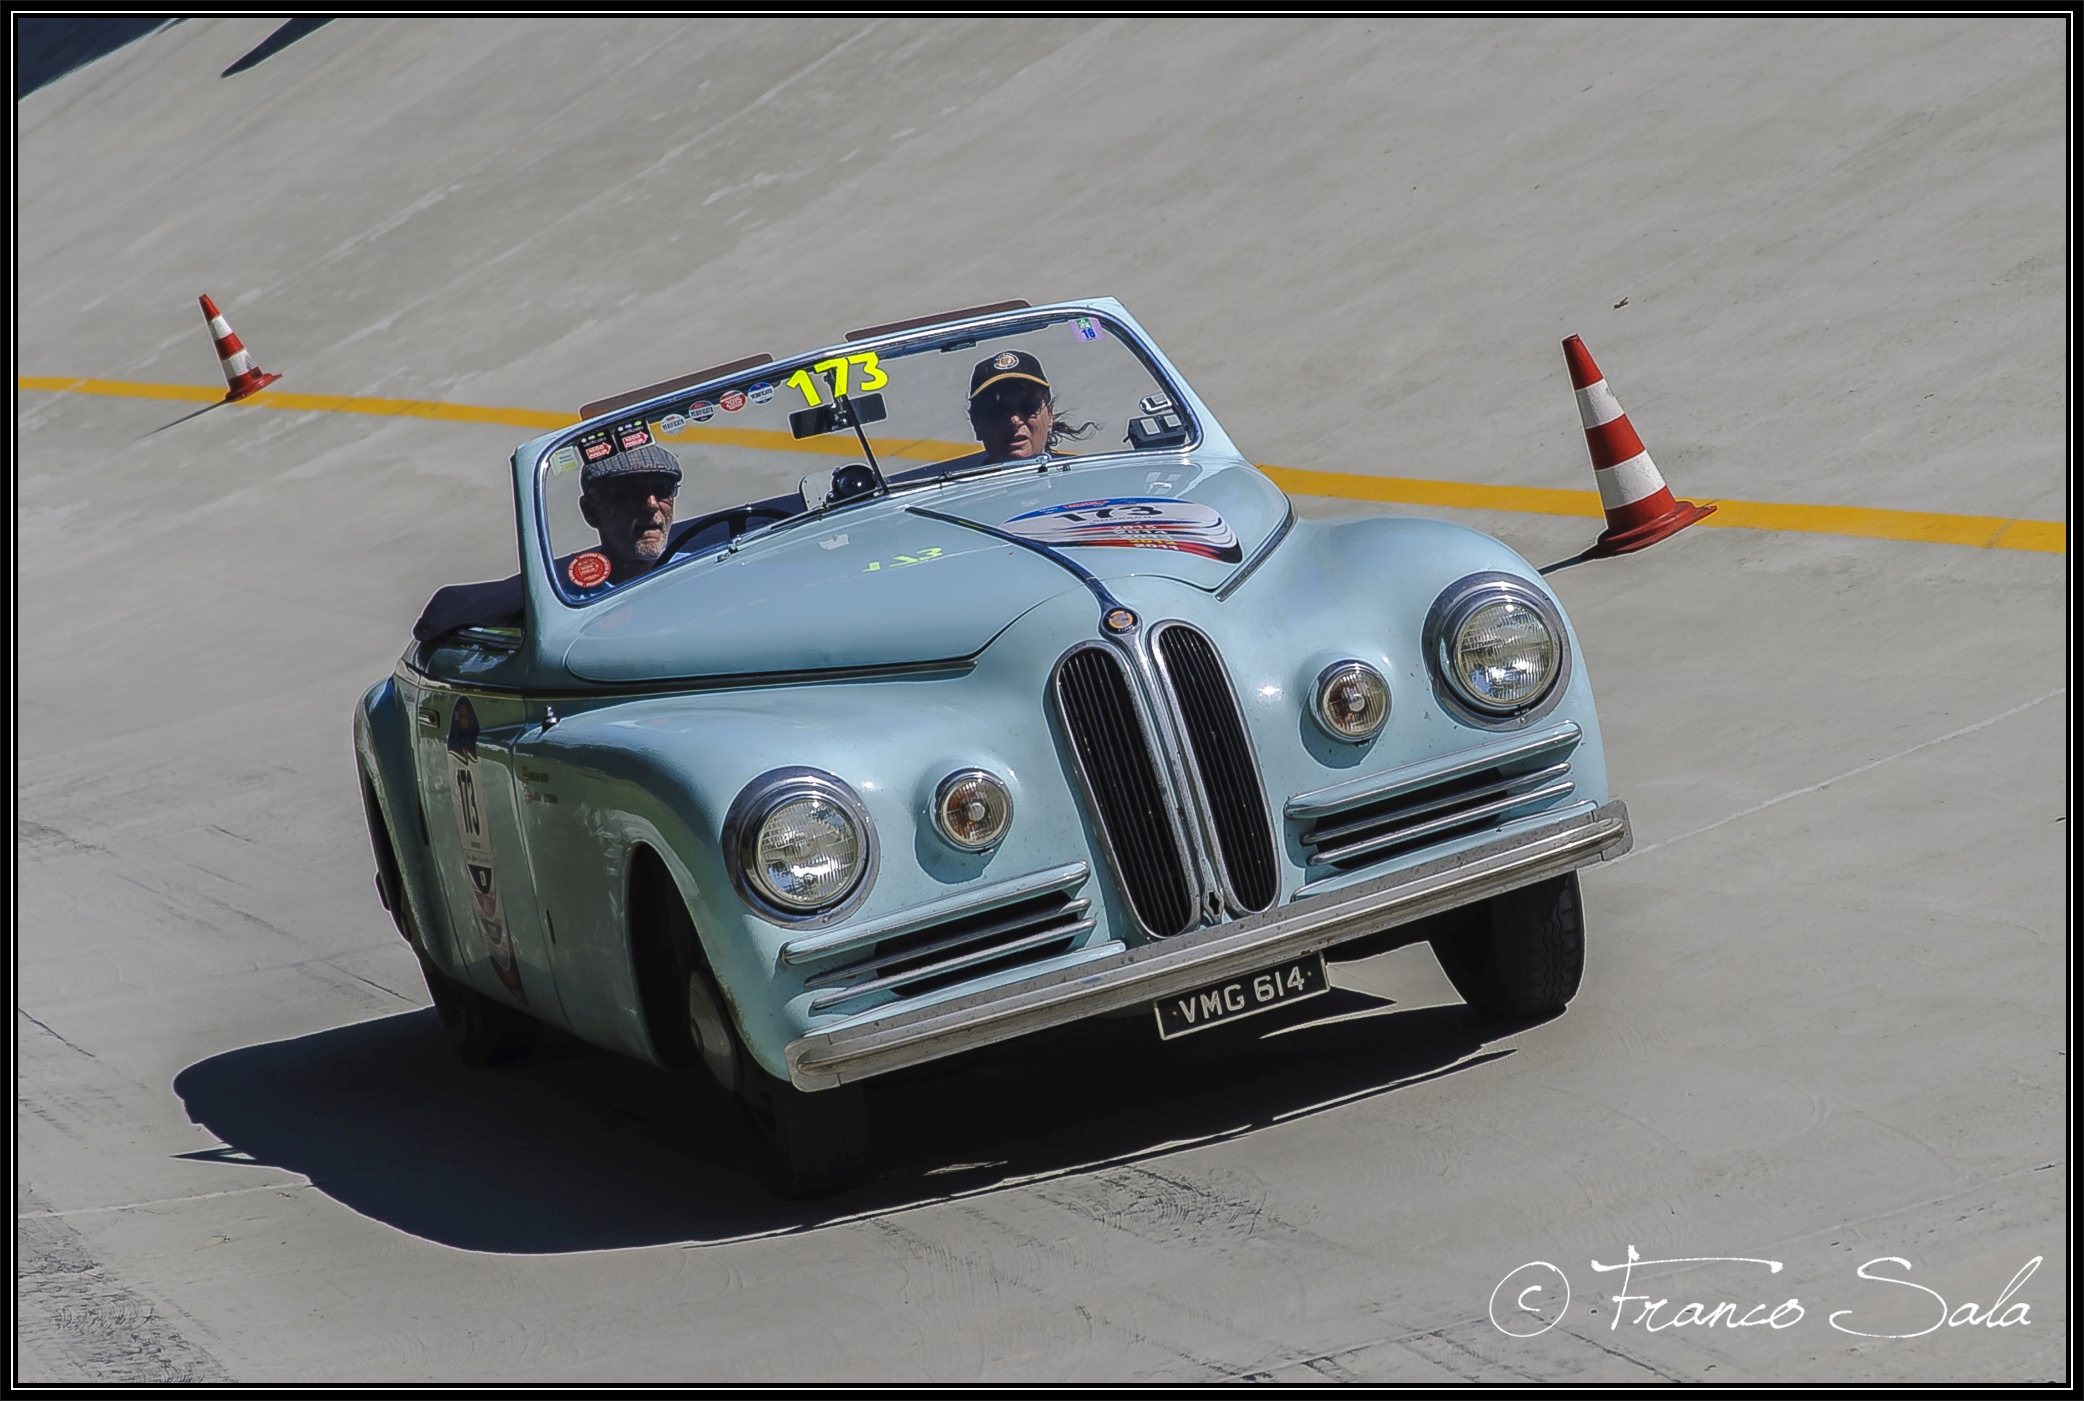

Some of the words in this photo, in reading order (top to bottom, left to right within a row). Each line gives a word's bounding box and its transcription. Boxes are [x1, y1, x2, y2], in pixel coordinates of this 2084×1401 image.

[787, 352, 888, 406] 173
[724, 395, 742, 408] 2015
[690, 405, 714, 417] VERIFICATO
[662, 418, 685, 431] VERIFICATO
[1053, 505, 1163, 522] 173
[457, 769, 480, 836] 173
[1178, 983, 1245, 1023] VMG
[1253, 966, 1305, 1003] 614
